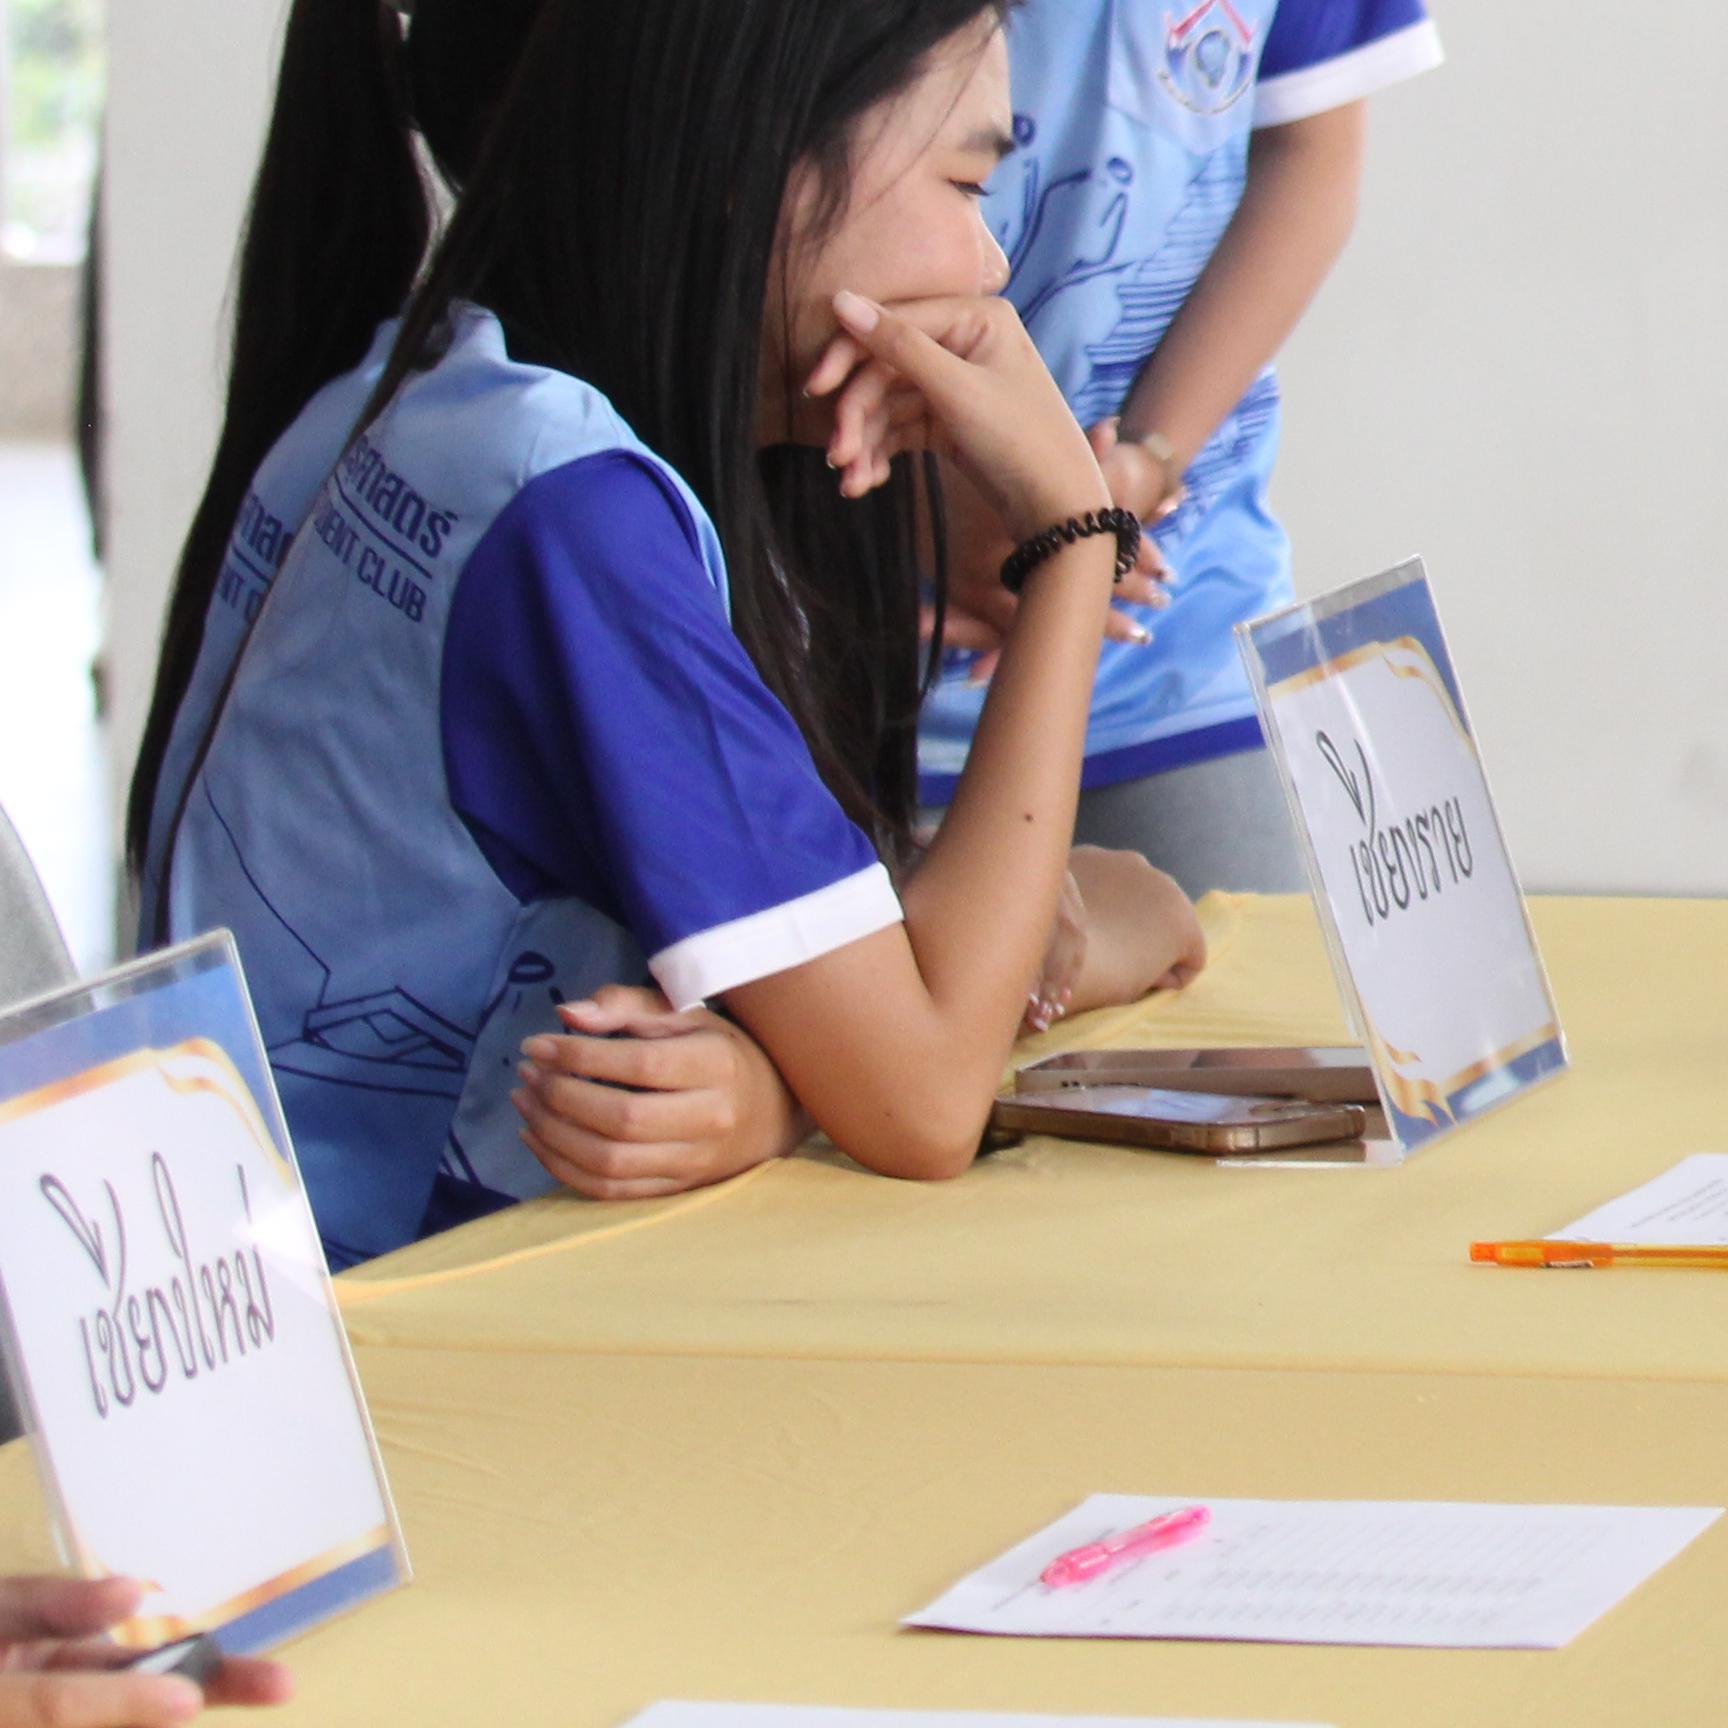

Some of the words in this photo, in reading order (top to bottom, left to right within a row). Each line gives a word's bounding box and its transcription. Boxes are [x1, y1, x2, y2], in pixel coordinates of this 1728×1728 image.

[357, 546, 427, 623] CLUB
[1316, 730, 1474, 928] เชียงราย
[38, 1149, 276, 1419] เชียงใหม่
